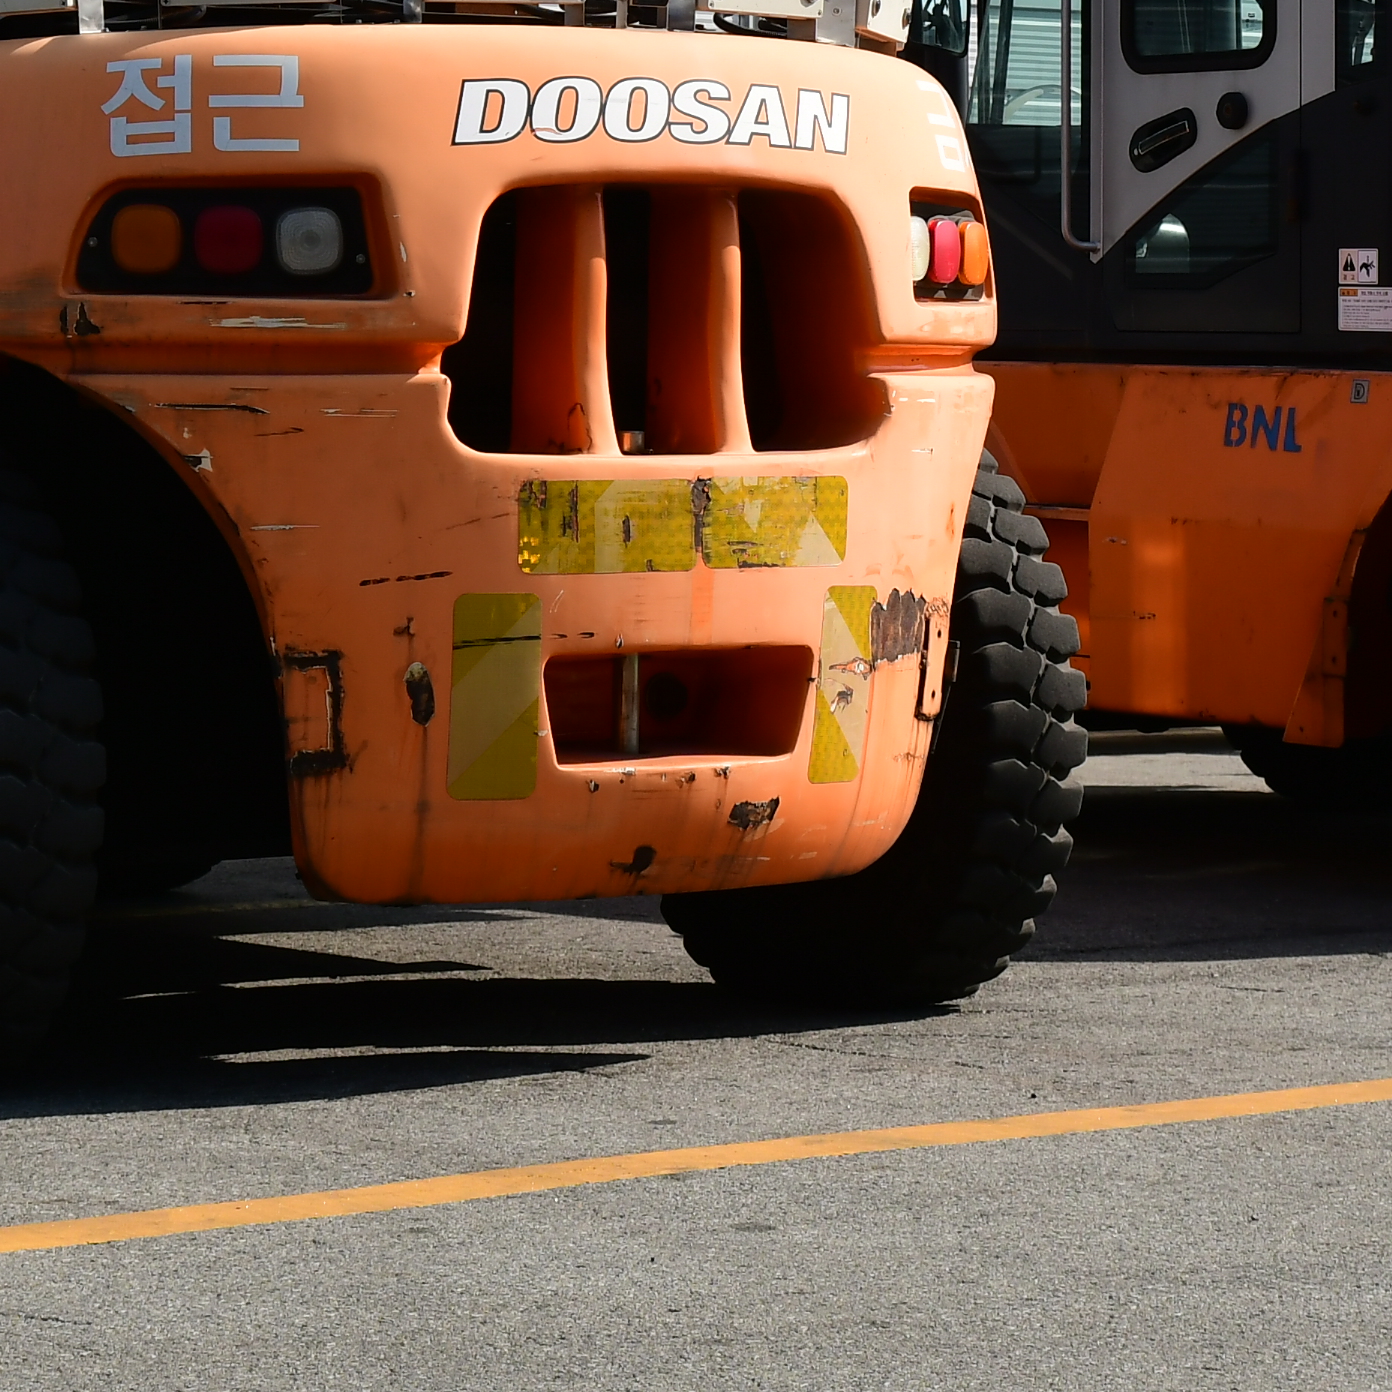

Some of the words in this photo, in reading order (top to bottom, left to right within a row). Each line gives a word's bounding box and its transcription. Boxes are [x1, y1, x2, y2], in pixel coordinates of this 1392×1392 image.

[100, 54, 304, 158] 접근
[451, 75, 850, 155] DOOSAN
[1224, 403, 1302, 453] BNL
